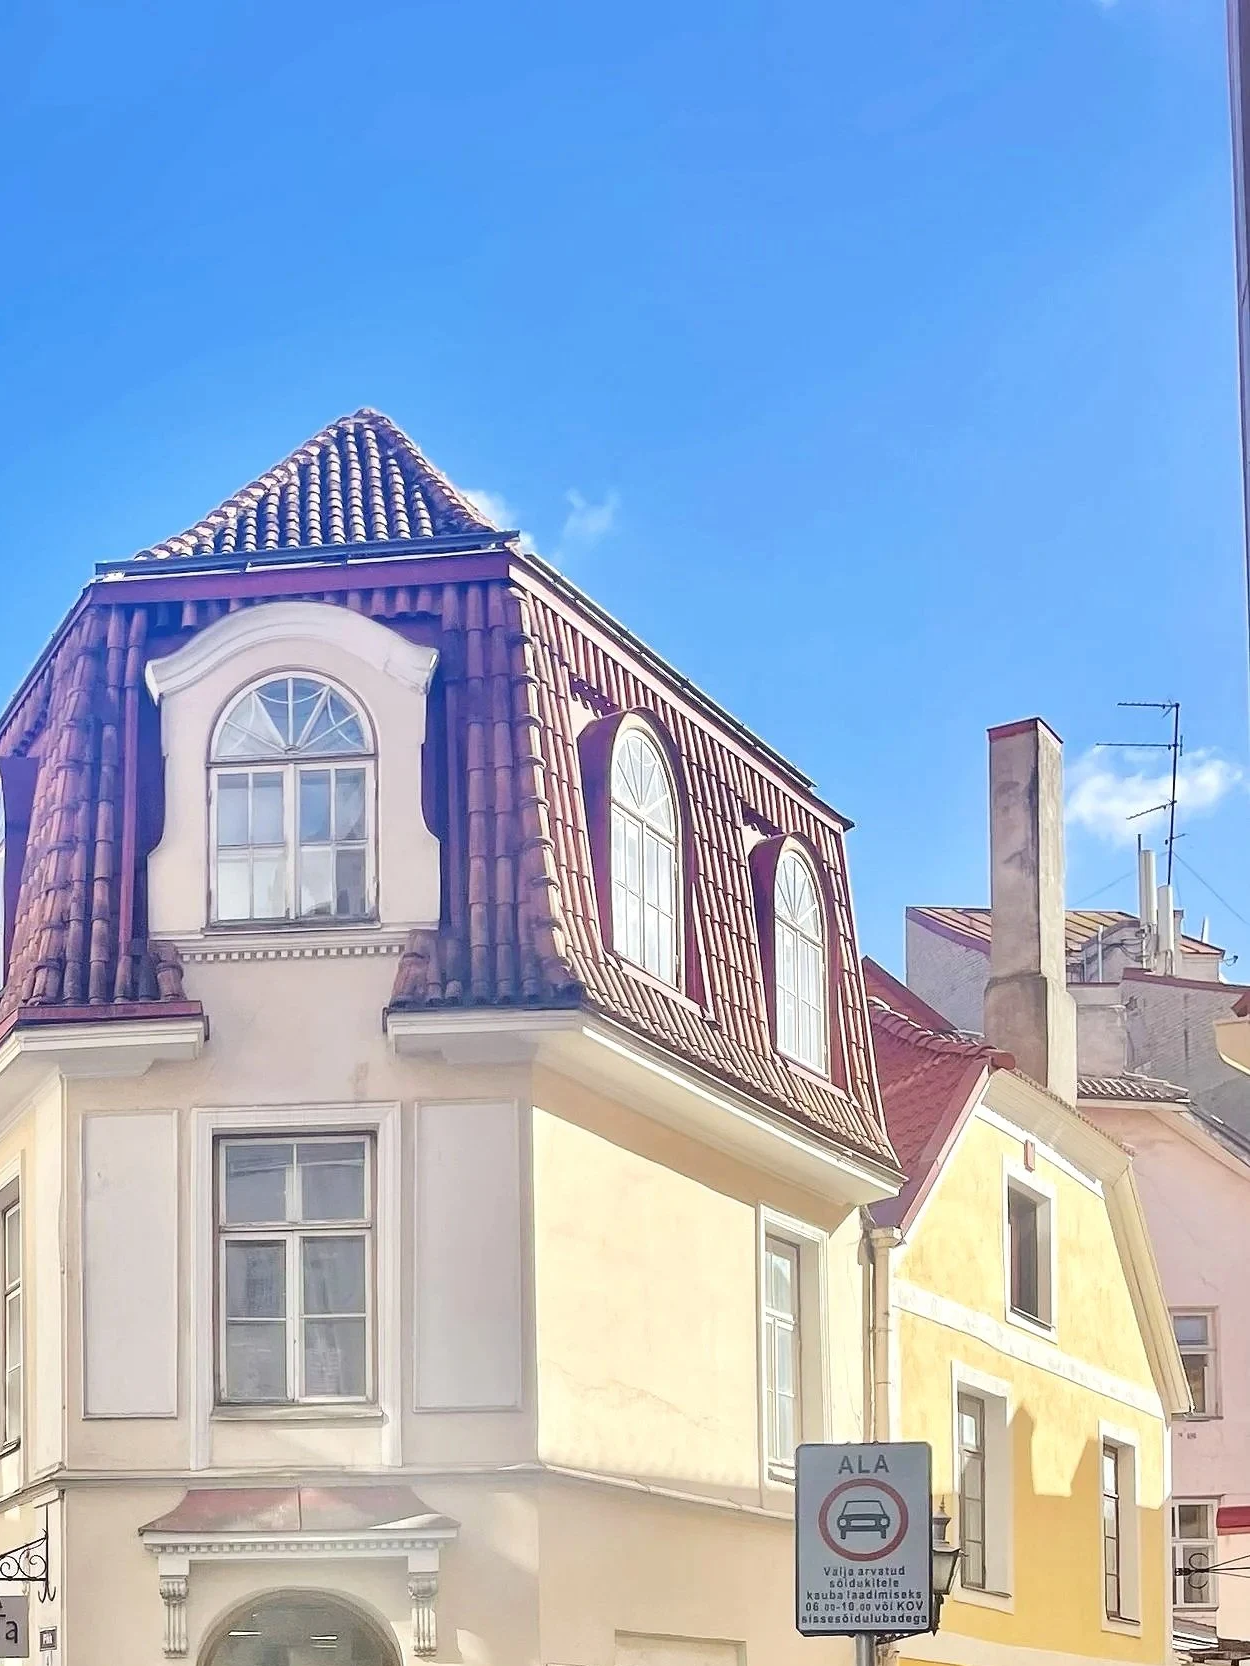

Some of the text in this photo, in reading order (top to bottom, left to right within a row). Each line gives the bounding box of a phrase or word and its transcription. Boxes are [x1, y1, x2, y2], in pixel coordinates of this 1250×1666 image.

[838, 1454, 890, 1474] ALA
[857, 1566, 906, 1576] arvatud
[806, 1589, 922, 1600] kauba laadimiseks
[896, 1601, 924, 1611] KOV
